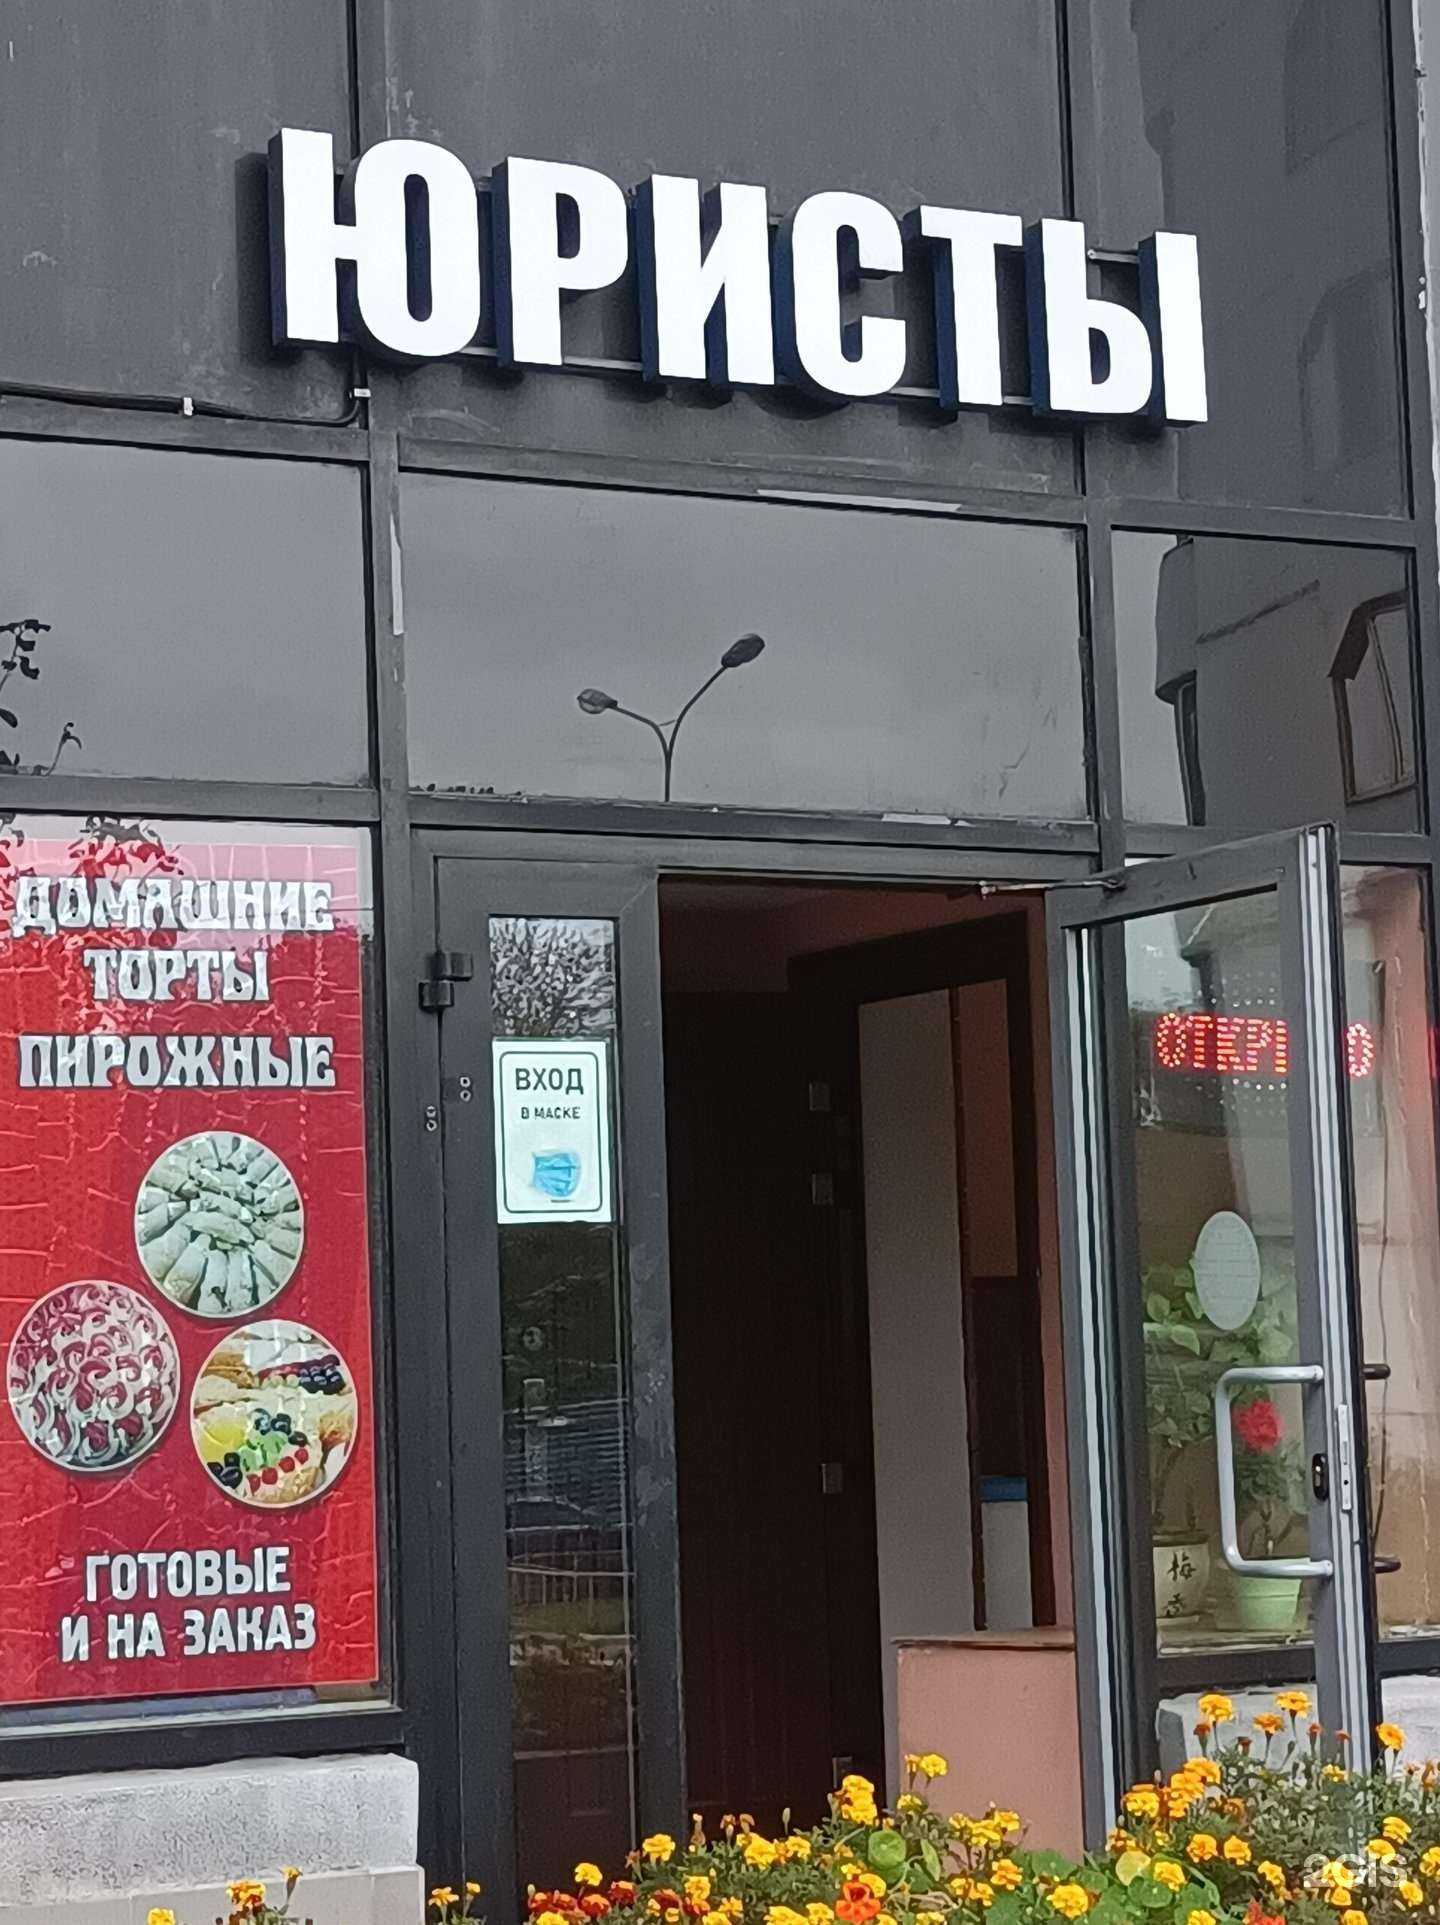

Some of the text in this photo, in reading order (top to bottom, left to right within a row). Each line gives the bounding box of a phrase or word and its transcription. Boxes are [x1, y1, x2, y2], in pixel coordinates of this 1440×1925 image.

[278, 127, 1209, 424] ЮРИСТЫ
[12, 876, 334, 937] ДОМАШНИЕ
[83, 949, 269, 1001] ТОРТЫ
[18, 1035, 336, 1087] ПИРОЖНЫЕ
[515, 1067, 584, 1095] ВХОД
[521, 1106, 581, 1120] В МАСКЕ
[85, 1546, 291, 1602] ГОТОВЫЕ
[61, 1602, 317, 1663] И НА ЗАКАЗ
